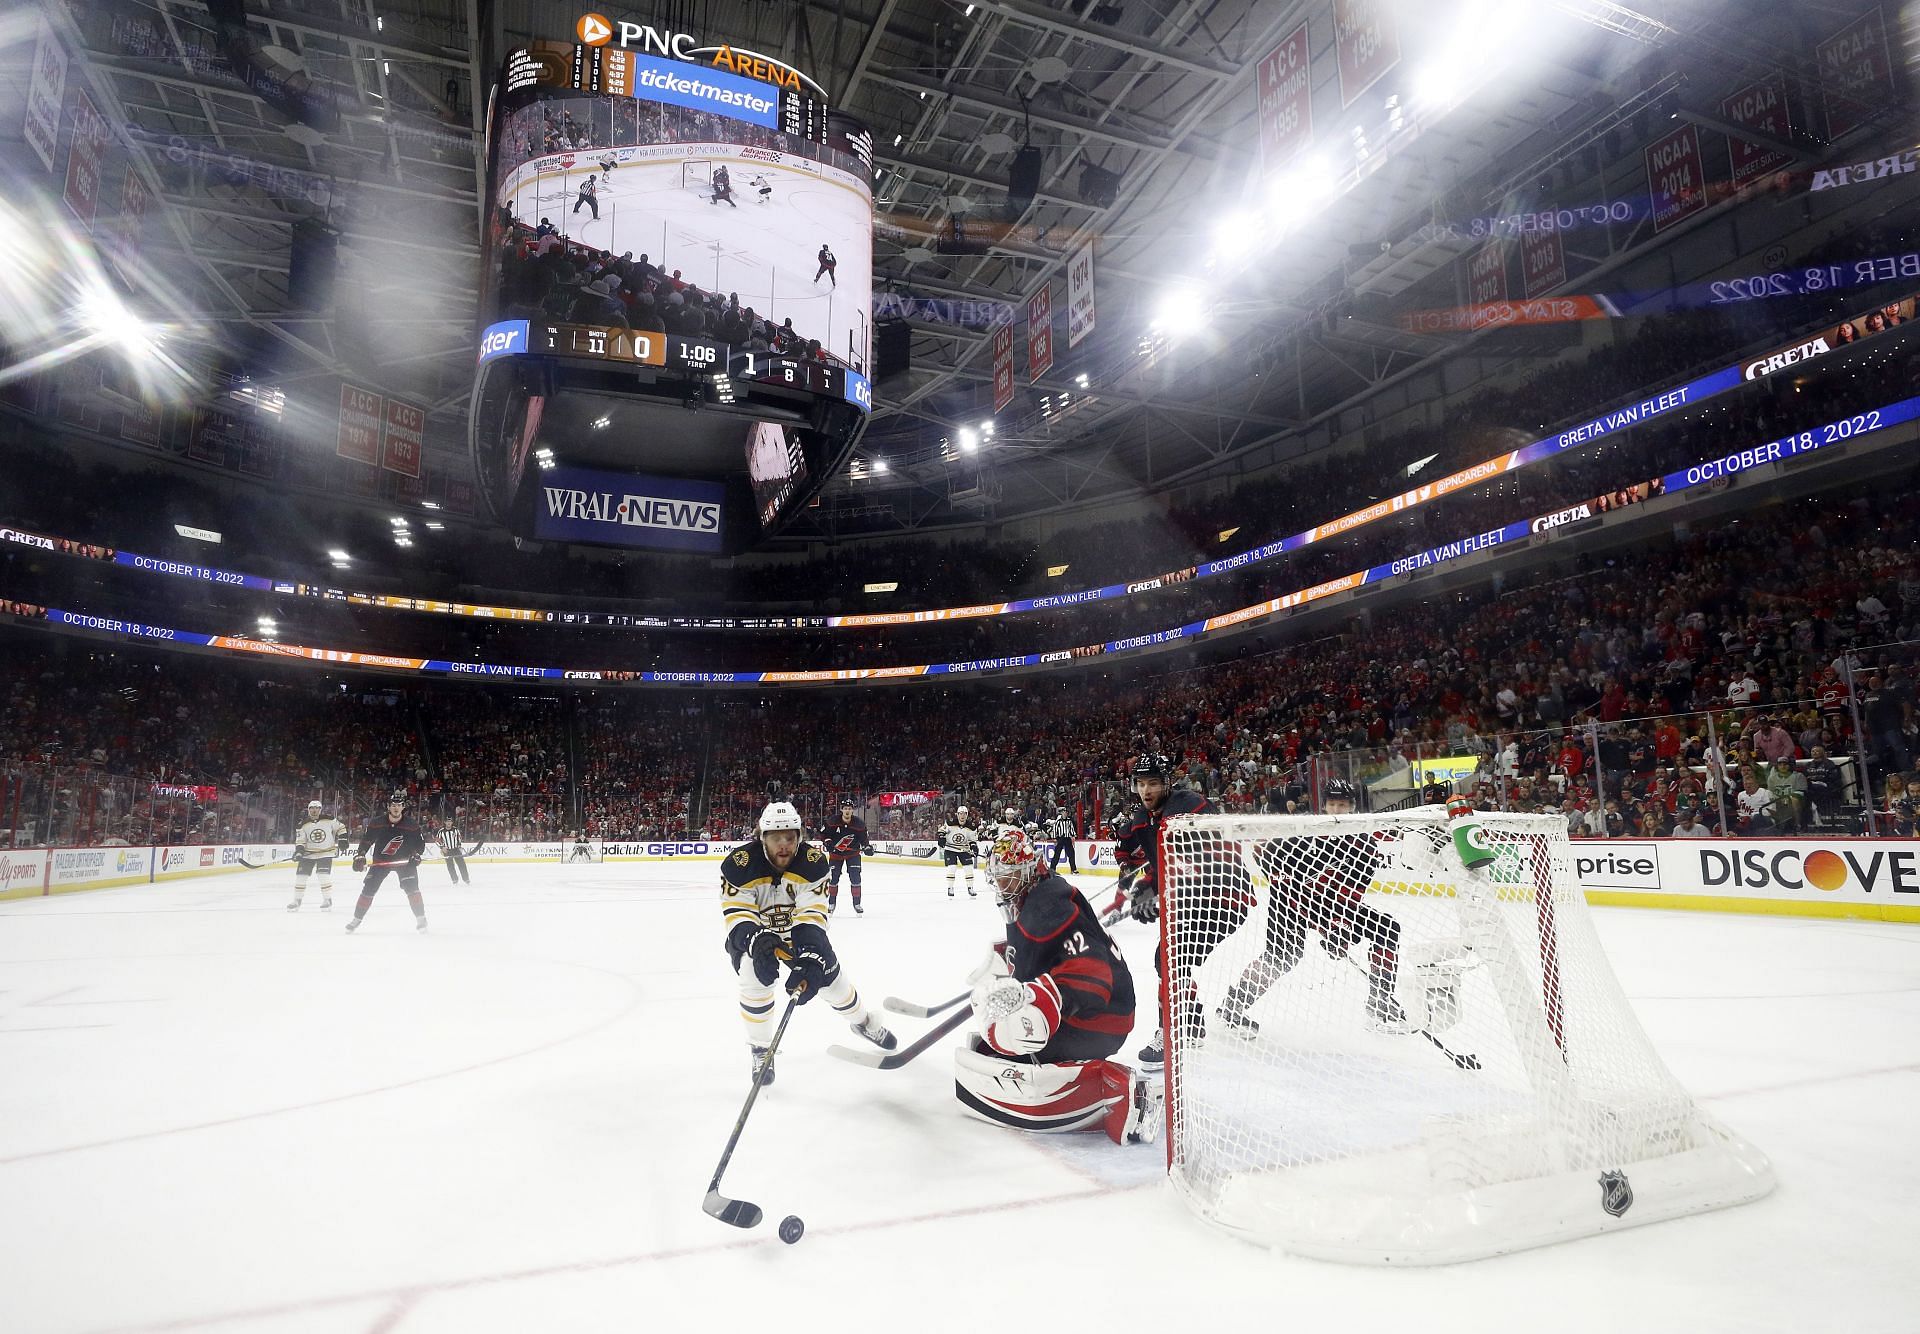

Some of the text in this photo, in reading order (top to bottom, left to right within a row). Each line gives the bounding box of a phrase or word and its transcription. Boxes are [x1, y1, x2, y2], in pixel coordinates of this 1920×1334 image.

[618, 21, 696, 60] PNC
[712, 44, 801, 91] ARENA
[1268, 40, 1296, 86] ACC
[640, 68, 775, 114] ticketmaster
[1262, 65, 1306, 118] CHAMPIONS
[1731, 86, 1777, 122] NCAA
[1273, 105, 1298, 142] 1955
[1653, 135, 1691, 172] NCAA
[1735, 160, 1759, 180] SWEET
[1661, 164, 1691, 200] 2014
[1072, 257, 1088, 292] 1974
[1033, 293, 1046, 320] ACC
[480, 330, 518, 358] ster
[548, 338, 555, 347] 1
[588, 339, 605, 353] 11
[634, 337, 650, 358] 0
[680, 343, 716, 363] 1:06
[997, 328, 1009, 356] ACC
[687, 361, 707, 369] FIRST
[745, 353, 757, 375] 1
[1745, 337, 1830, 381] GRETA
[785, 369, 794, 382] 8
[825, 379, 829, 388] 1
[351, 391, 373, 412] ACC
[396, 407, 416, 426] ACC
[1559, 387, 1689, 448] GRETA VAN FLEET
[388, 422, 421, 444] CHAMPIONS
[394, 442, 412, 459] 1973
[1687, 410, 1882, 484] OCTOBER 18, 2022
[1436, 462, 1498, 494] @PNCARENA
[544, 487, 718, 530] WRAL NEWS
[1532, 504, 1591, 534] GRETA
[1321, 504, 1389, 536] STAY CONNECTED!
[0, 528, 54, 550] GRETA
[1210, 542, 1283, 574] OCTOBER 18, 2022
[1391, 528, 1506, 576] GRETA VAN FLEET
[134, 556, 244, 585] OCTOBER 18, 2022
[1127, 579, 1161, 594] GRETA
[1307, 576, 1353, 599] @PNCARENA
[1033, 589, 1102, 609] GRETA VAN FLEET
[547, 612, 553, 621] 0
[847, 613, 911, 625] STAY CONNECTED!
[950, 605, 995, 618] @PNCARENA
[1213, 606, 1267, 628] STAY CONNECTED!
[63, 612, 174, 640] OCTOBER 18, 2022
[225, 638, 304, 657] STAY CONNECTED!
[1114, 627, 1183, 651] OCTOBER 18, 2022
[359, 655, 411, 667] @PNCARENA
[948, 655, 1026, 673] GRETA VAN FLEET
[1040, 650, 1071, 662] GRETA
[451, 663, 546, 677] GRETA VAN FLEET
[564, 670, 601, 680] GRETA
[653, 672, 734, 682] OCTOBER 18, 2022
[771, 671, 832, 681] STAY CONNECTED!
[876, 666, 916, 677] @PNCARENA
[169, 850, 185, 866] pepsi
[222, 848, 243, 864] GEICO
[648, 843, 708, 856] GEICO
[1100, 847, 1115, 859] pep
[13, 864, 36, 880] SPORTS
[125, 860, 144, 873] Lottery
[1576, 853, 1654, 878] prise
[1063, 931, 1089, 955] 32
